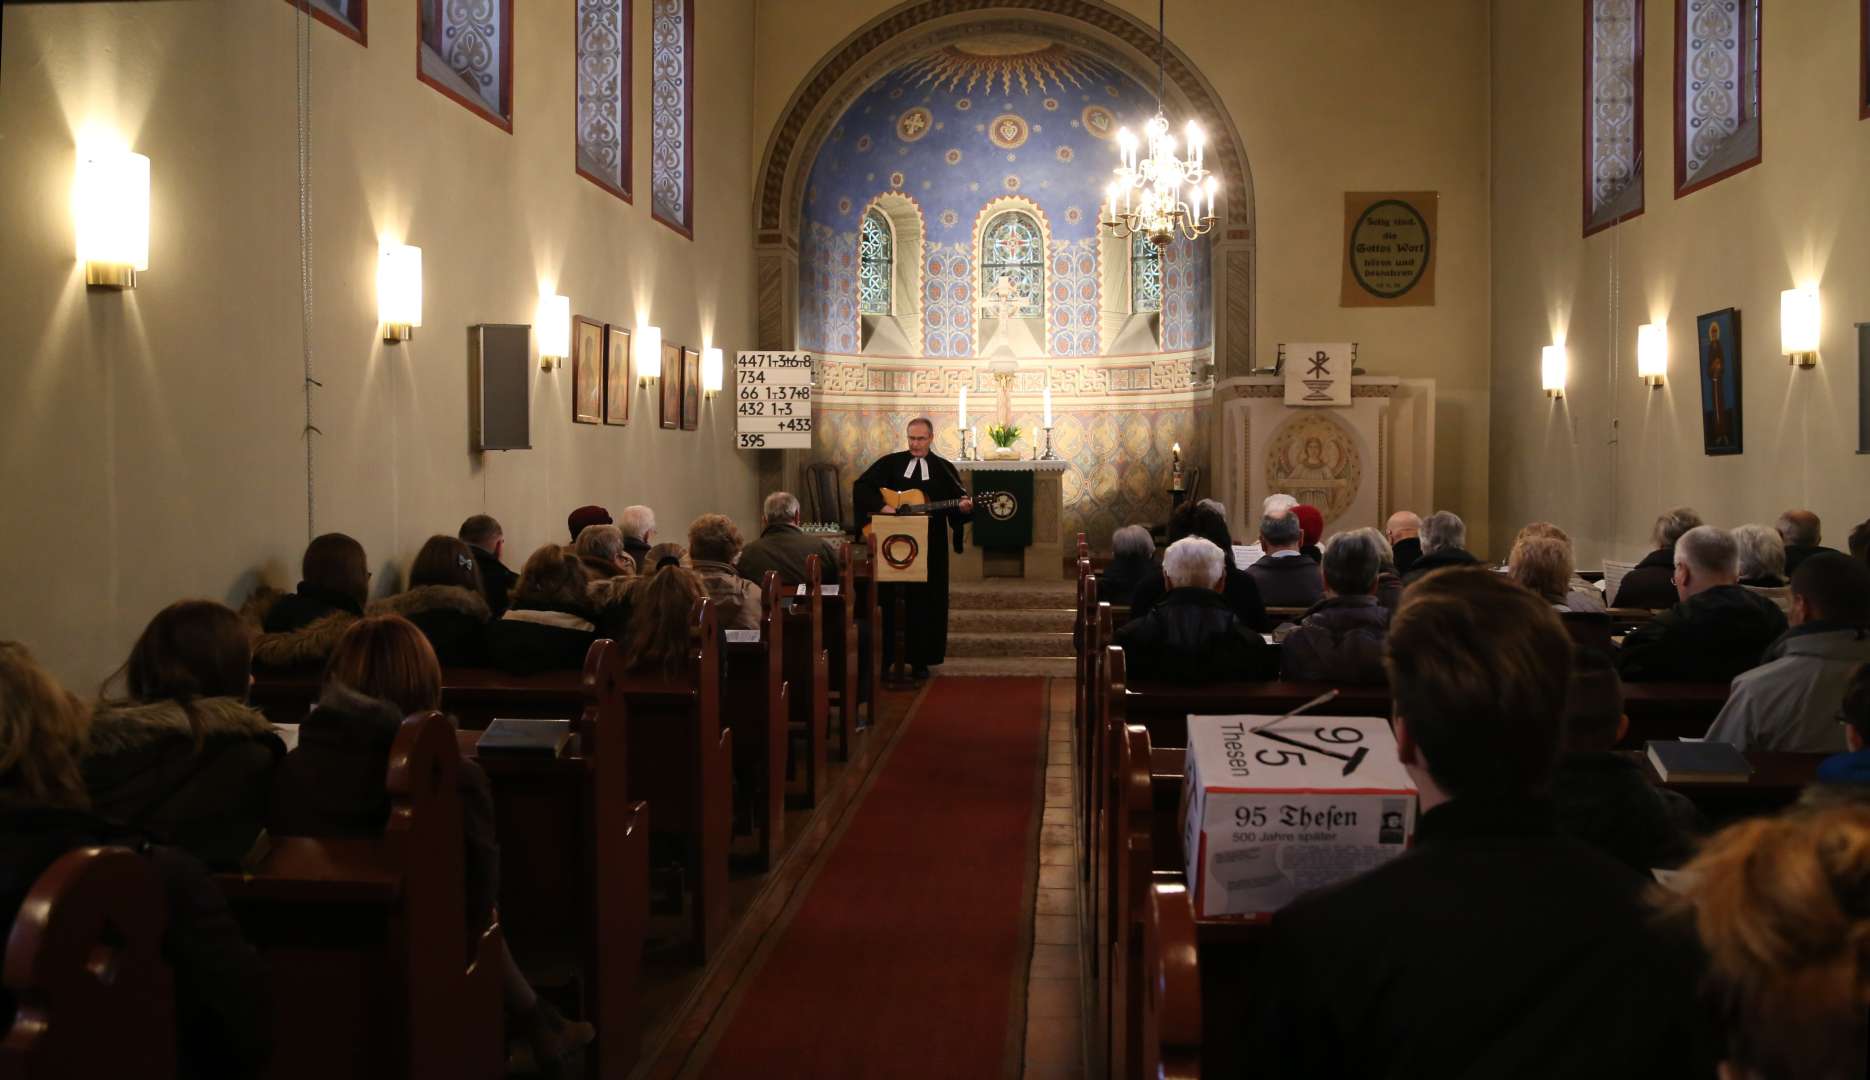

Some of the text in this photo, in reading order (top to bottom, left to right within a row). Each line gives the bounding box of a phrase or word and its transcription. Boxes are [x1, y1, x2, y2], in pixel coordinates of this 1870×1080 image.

[1356, 243, 1424, 253] Gottes Wort
[738, 355, 765, 367] 447
[739, 371, 766, 383] 734
[740, 387, 759, 400] 66
[738, 402, 764, 415] 432
[740, 434, 765, 447] 395
[1220, 722, 1250, 777] Thesen
[1234, 806, 1267, 827] 95
[1232, 831, 1337, 843] 500 Jahre später
